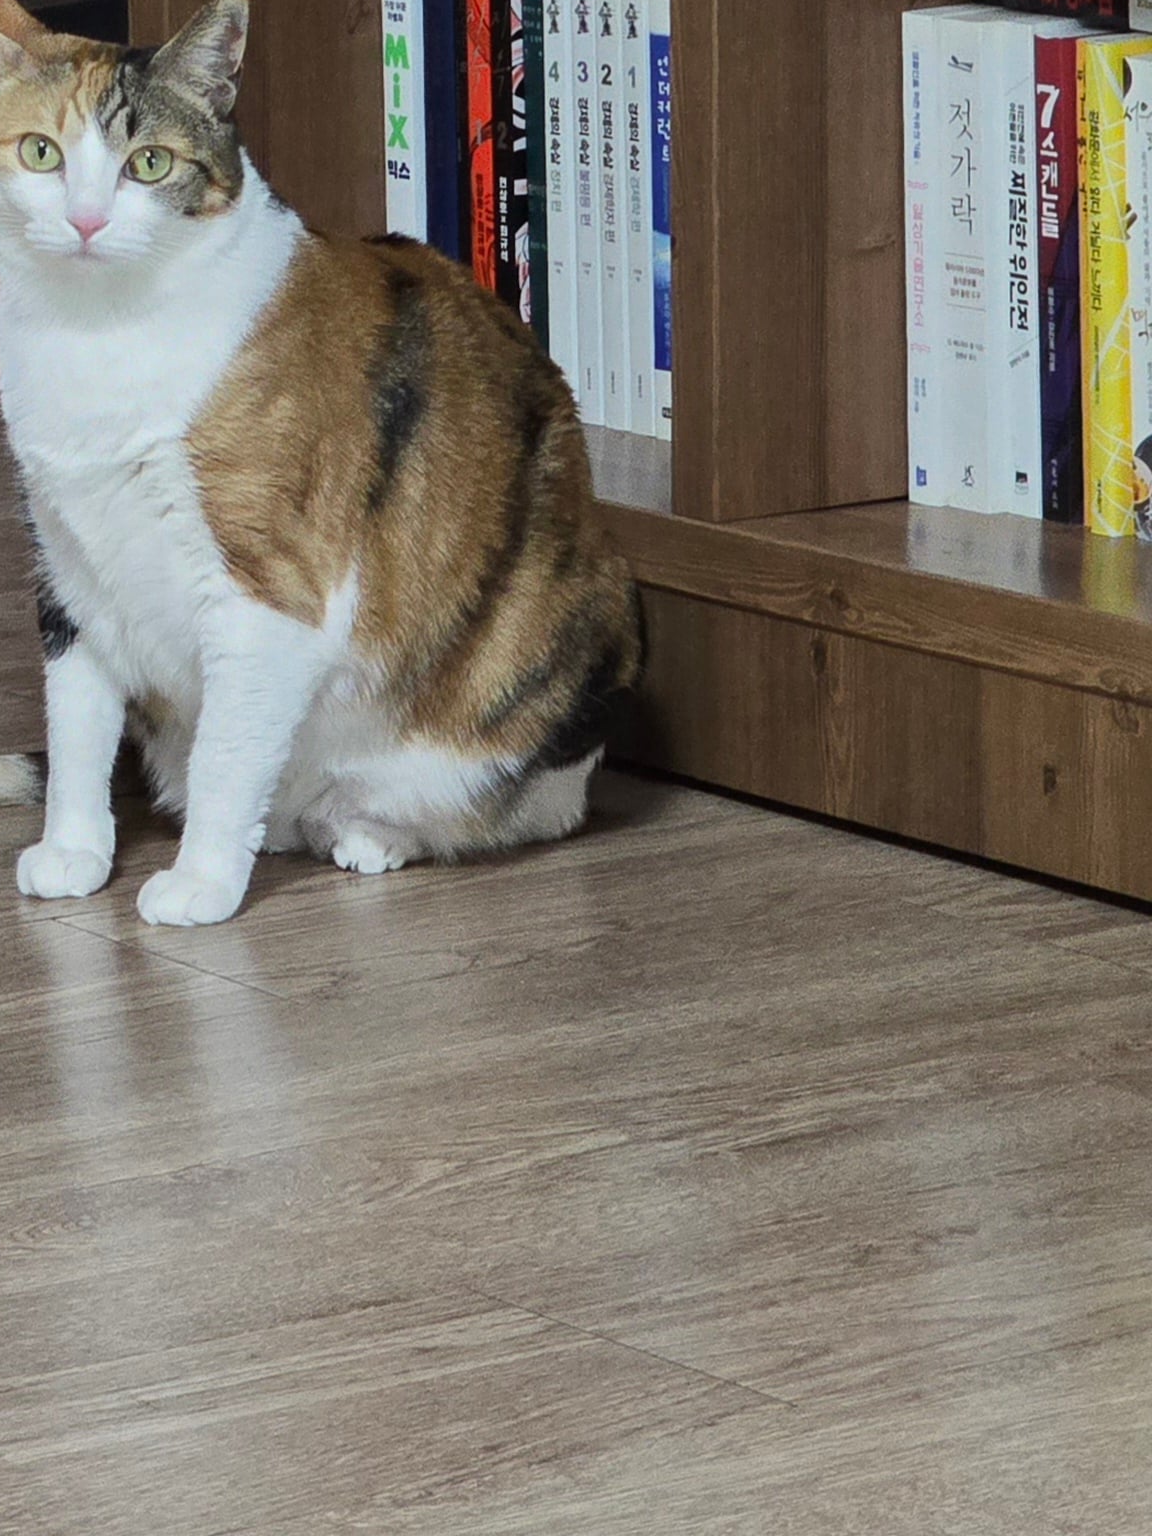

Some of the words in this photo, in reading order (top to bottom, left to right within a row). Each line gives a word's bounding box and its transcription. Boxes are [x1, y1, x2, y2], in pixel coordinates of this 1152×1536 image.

[385, 32, 410, 151] MiX
[549, 60, 560, 83] 4
[578, 60, 589, 83] 3
[601, 64, 613, 86] 2
[628, 66, 636, 88] 1
[497, 120, 508, 150] 2
[549, 96, 560, 136] 경제의
[578, 96, 590, 137] 경제의
[601, 100, 613, 140] 경제의
[628, 102, 640, 142] 경제의
[550, 138, 561, 165] 속살
[579, 138, 590, 166] 속살
[603, 142, 614, 169] 속살
[629, 144, 641, 171] 속살
[1088, 109, 1101, 181] 광화문에서
[387, 159, 411, 181] 믹스
[948, 97, 977, 236] 젓가락
[1008, 169, 1029, 250] 찌질한
[1089, 186, 1101, 216] 읽다
[1089, 221, 1102, 262] 거닐다
[911, 203, 925, 327] 일상기술연구소
[1008, 254, 1030, 331] 위인전
[1090, 268, 1102, 311] 느끼다
